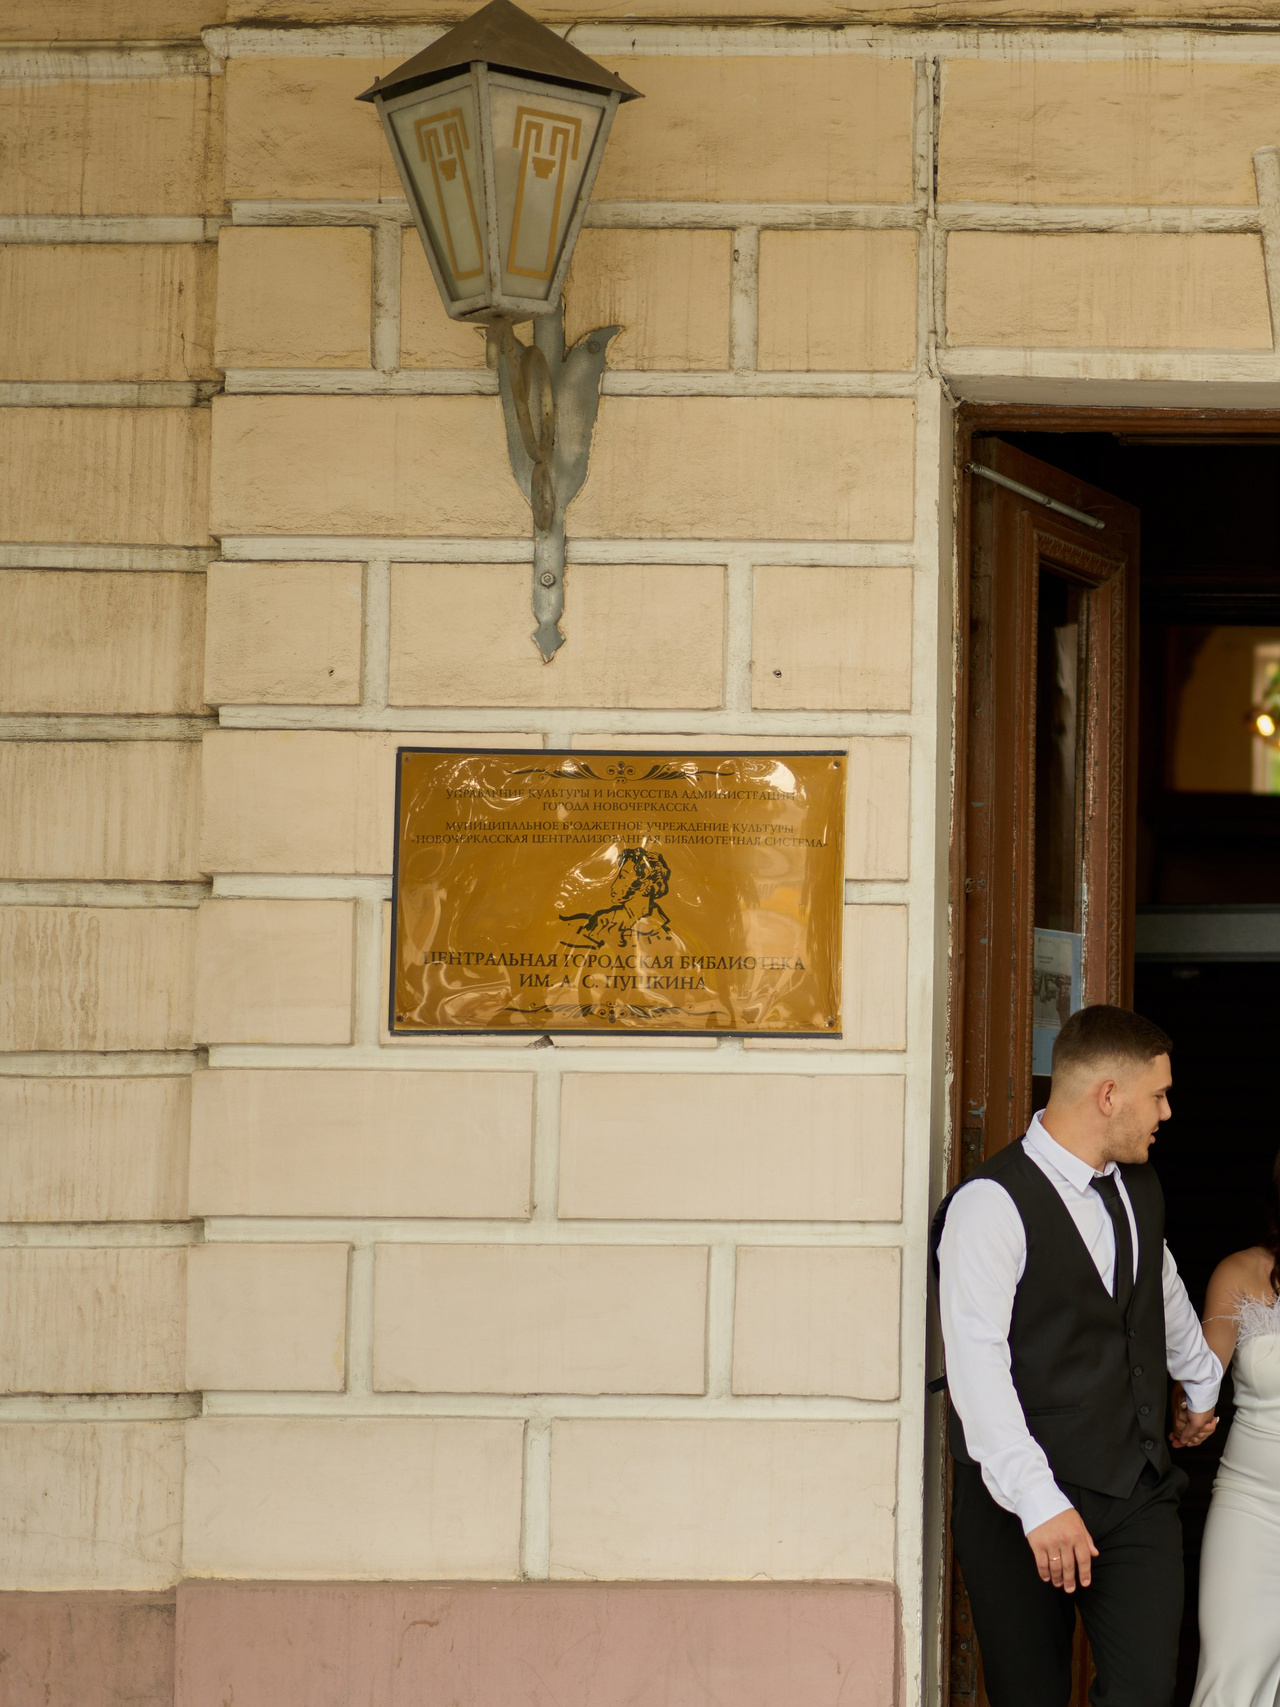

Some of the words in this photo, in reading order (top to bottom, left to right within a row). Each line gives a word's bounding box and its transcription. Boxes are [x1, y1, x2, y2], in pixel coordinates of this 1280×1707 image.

[529, 789, 590, 799] КУЛЬТУРЫ
[594, 789, 603, 798] И
[607, 789, 678, 799] ИСКУССТВА
[543, 802, 590, 812] ГОРОДА
[593, 802, 698, 812] НОВОЧЕРКАССКА
[445, 821, 559, 832] МУНИЦИПАЛЬНОЕ
[562, 821, 642, 832] БЮДЖЕТНОЕ
[646, 822, 730, 833] УЧРЕЖДЕНИЕ
[732, 823, 794, 834] КУЛЬТУРЫ
[532, 834, 661, 845] ЦЕНТРАЛИЗОВАННАЯ
[664, 835, 761, 846] БИБЛИОТЕЧНАЯ
[423, 951, 558, 968] ЦЕНТРАЛЬНАЯ
[564, 953, 674, 971] ГОРОДСКАЯ
[679, 955, 806, 971] БИБЛИОТЕКА
[519, 973, 553, 988] ИМ.
[559, 975, 576, 988] А.
[582, 975, 599, 989] С.
[605, 975, 706, 992] ПУШКИНА
